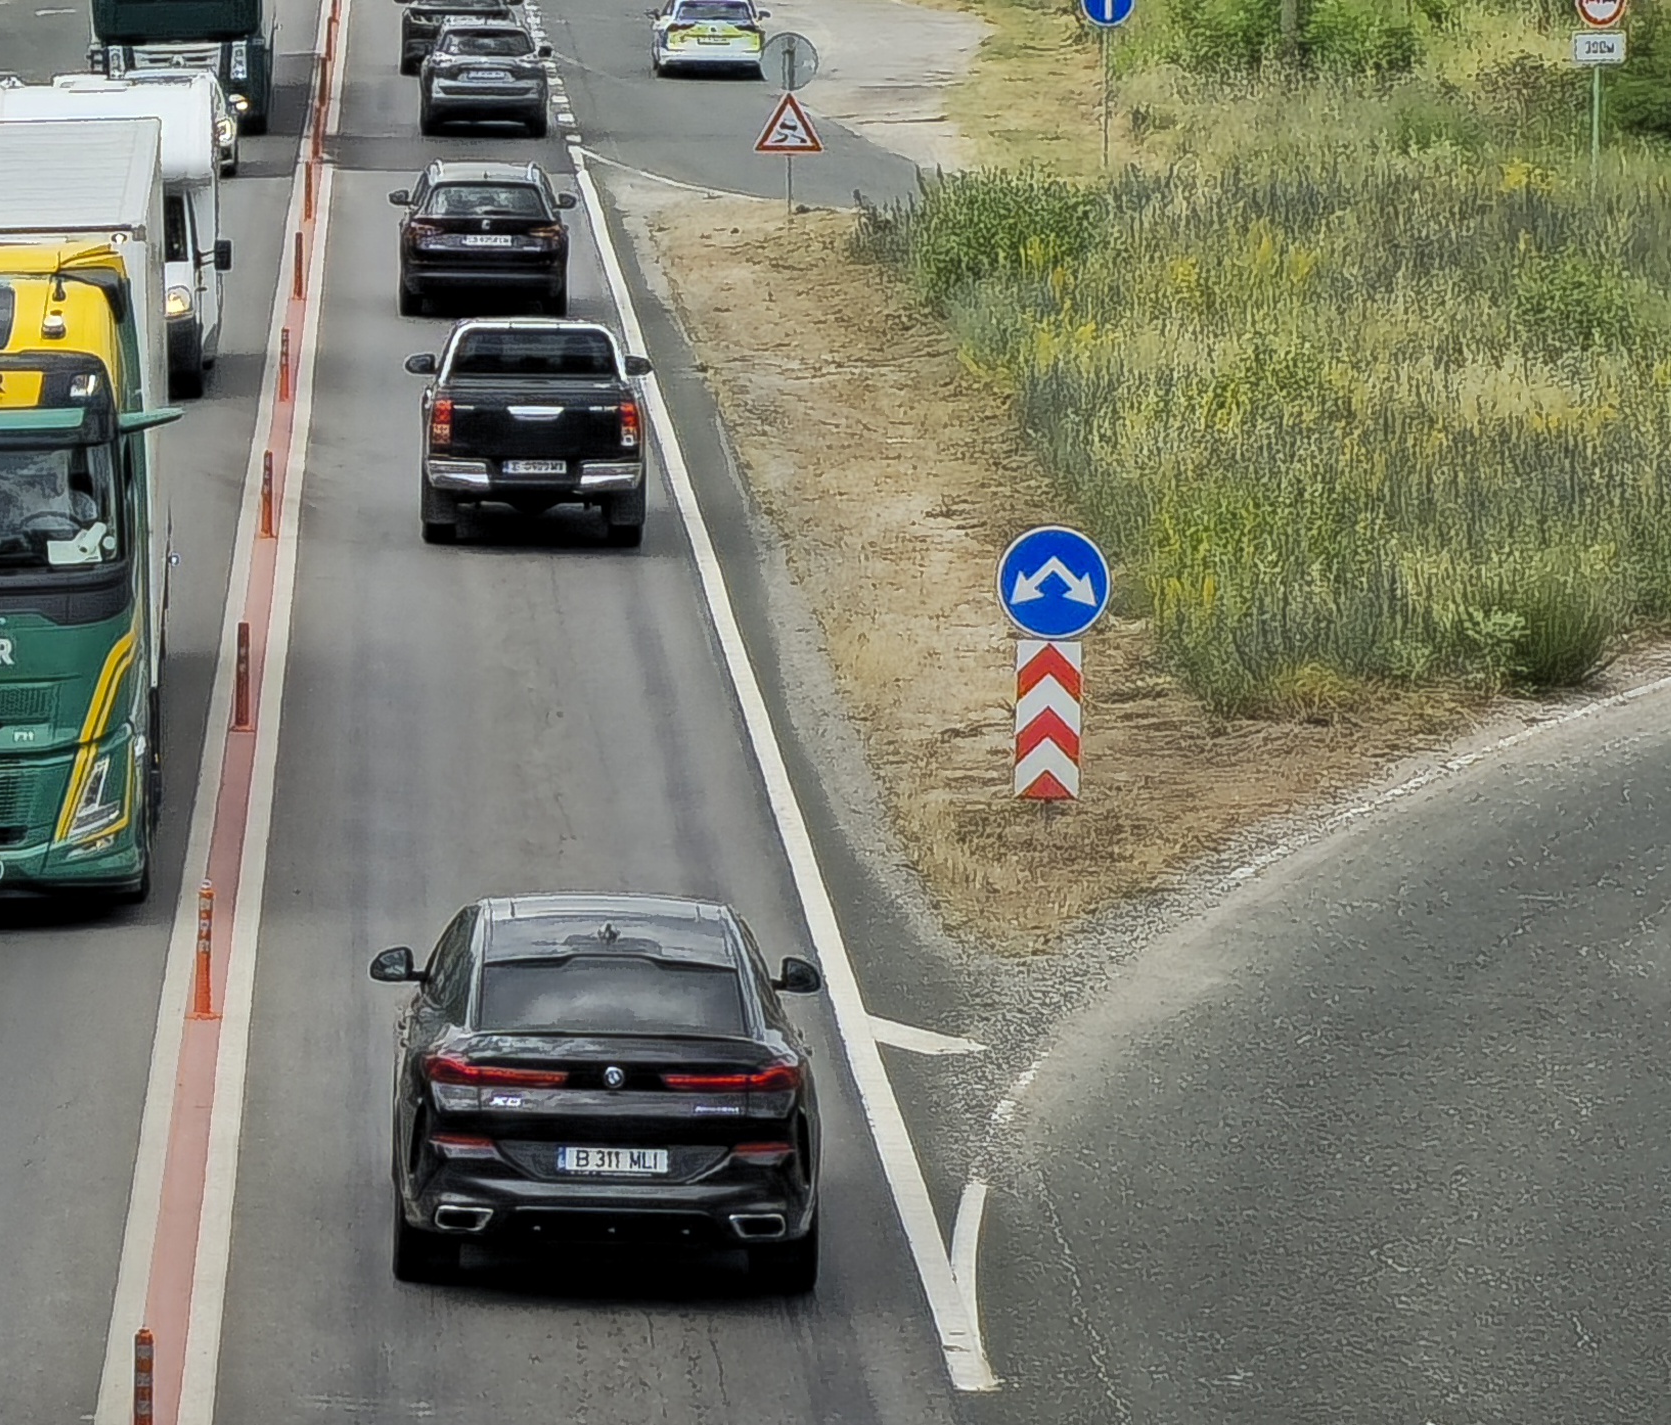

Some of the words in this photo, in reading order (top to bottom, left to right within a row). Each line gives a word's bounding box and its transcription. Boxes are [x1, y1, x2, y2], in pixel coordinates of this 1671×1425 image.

[575, 1149, 590, 1168] B
[595, 1149, 620, 1169] 311
[629, 1151, 658, 1170] MLI
